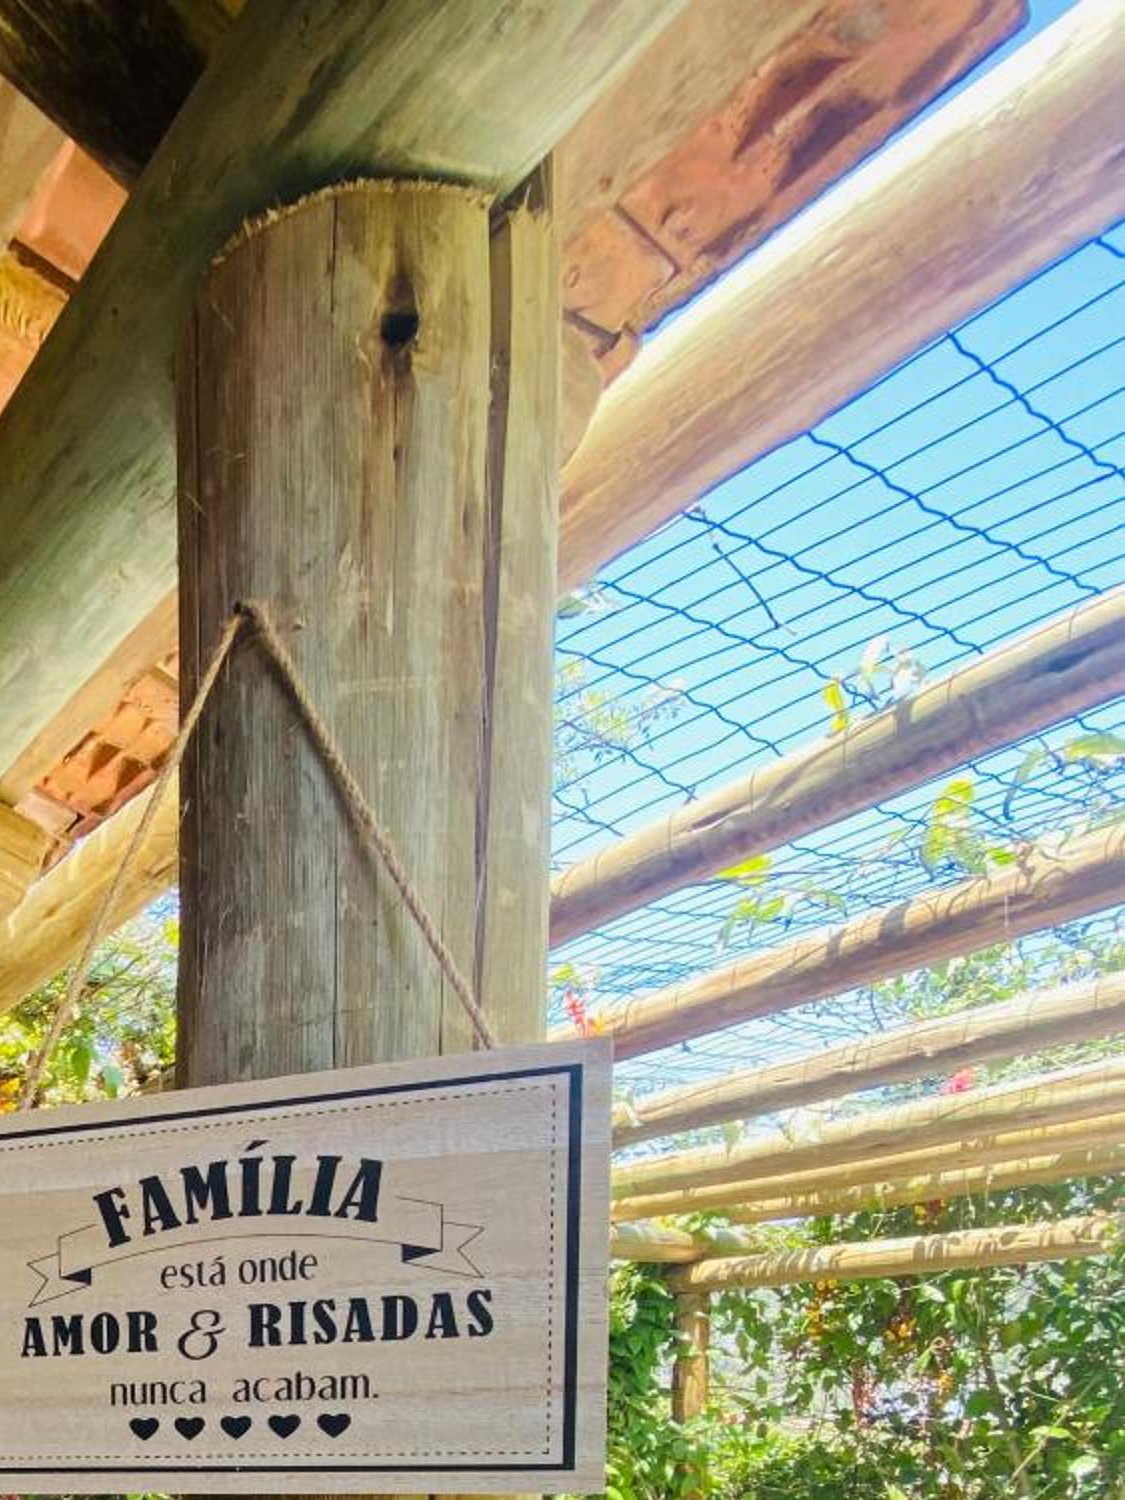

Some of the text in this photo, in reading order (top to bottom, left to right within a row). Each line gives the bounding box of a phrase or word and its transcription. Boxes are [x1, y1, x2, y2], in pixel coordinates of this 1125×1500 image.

[92, 1139, 383, 1249] FAMÍLIA
[160, 1250, 318, 1289] está onde
[20, 1288, 495, 1361] AMOR & RISADAS
[110, 1371, 380, 1407] nunca acabam.
